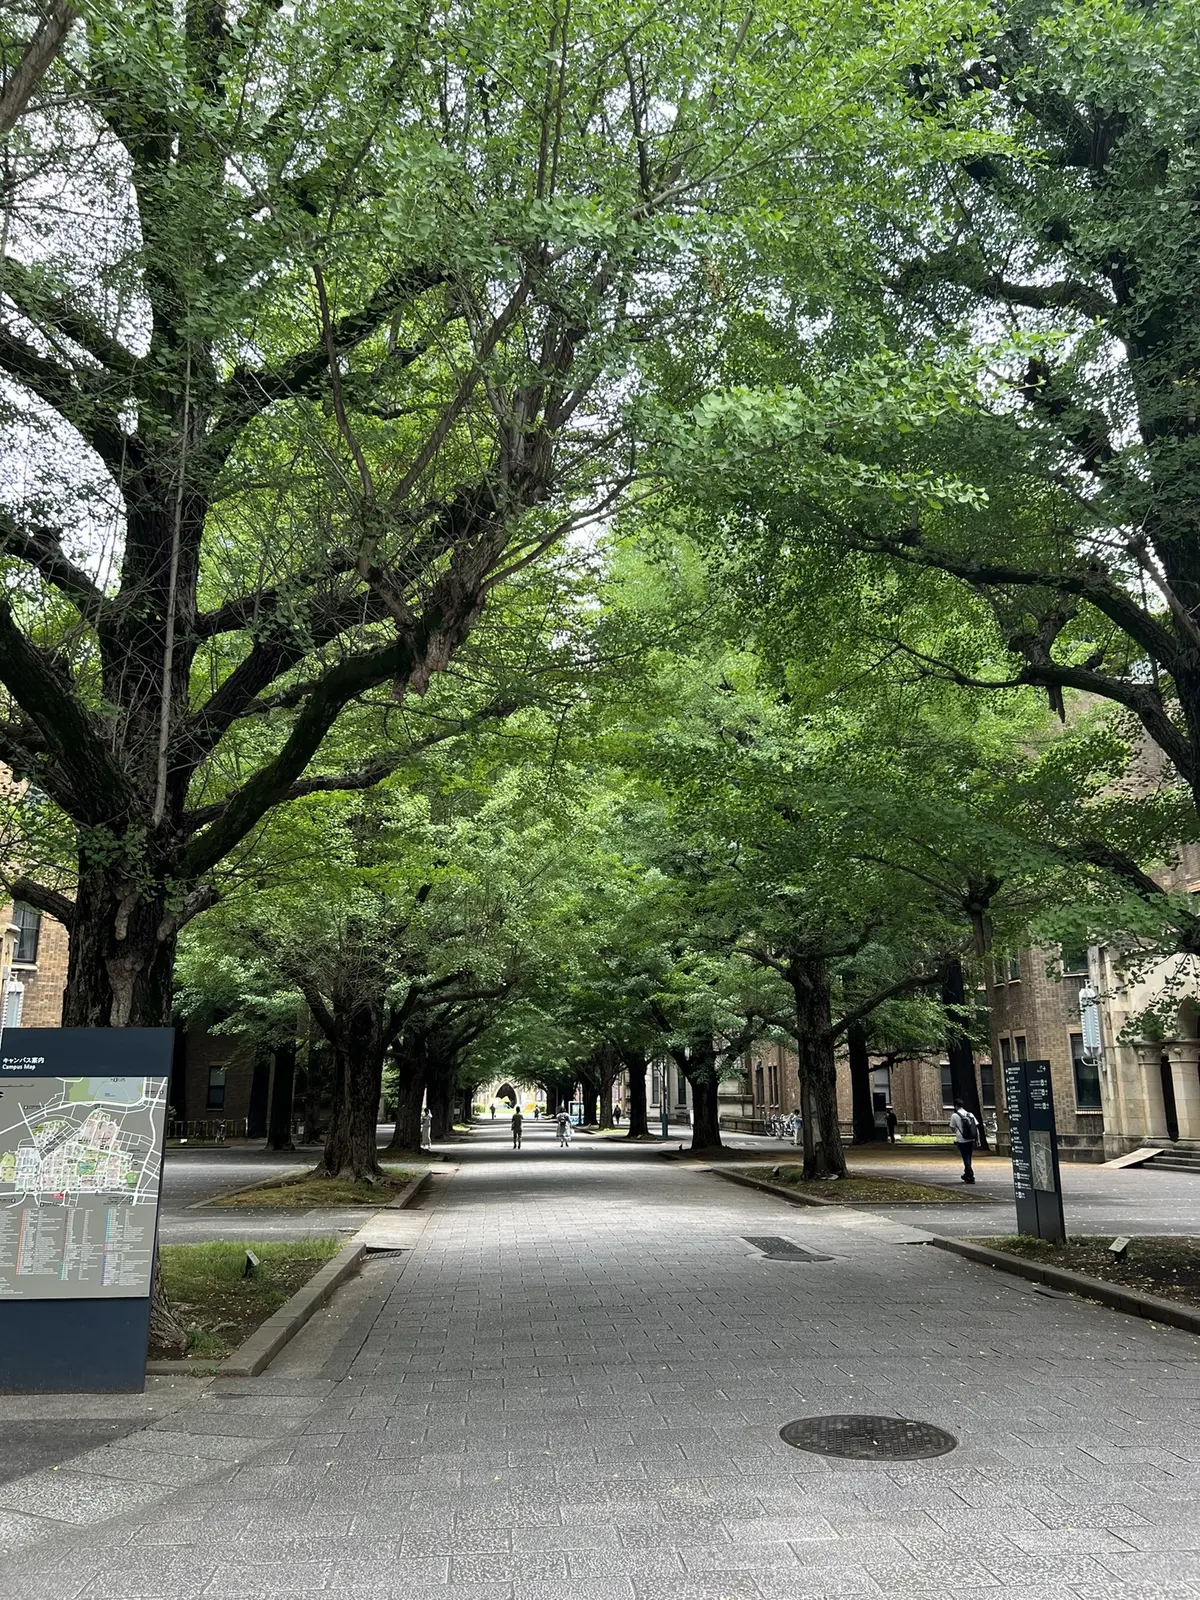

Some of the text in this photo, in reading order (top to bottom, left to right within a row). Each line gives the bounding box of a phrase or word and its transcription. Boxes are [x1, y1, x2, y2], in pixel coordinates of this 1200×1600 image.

[2, 1056, 45, 1064] キャンパス案内
